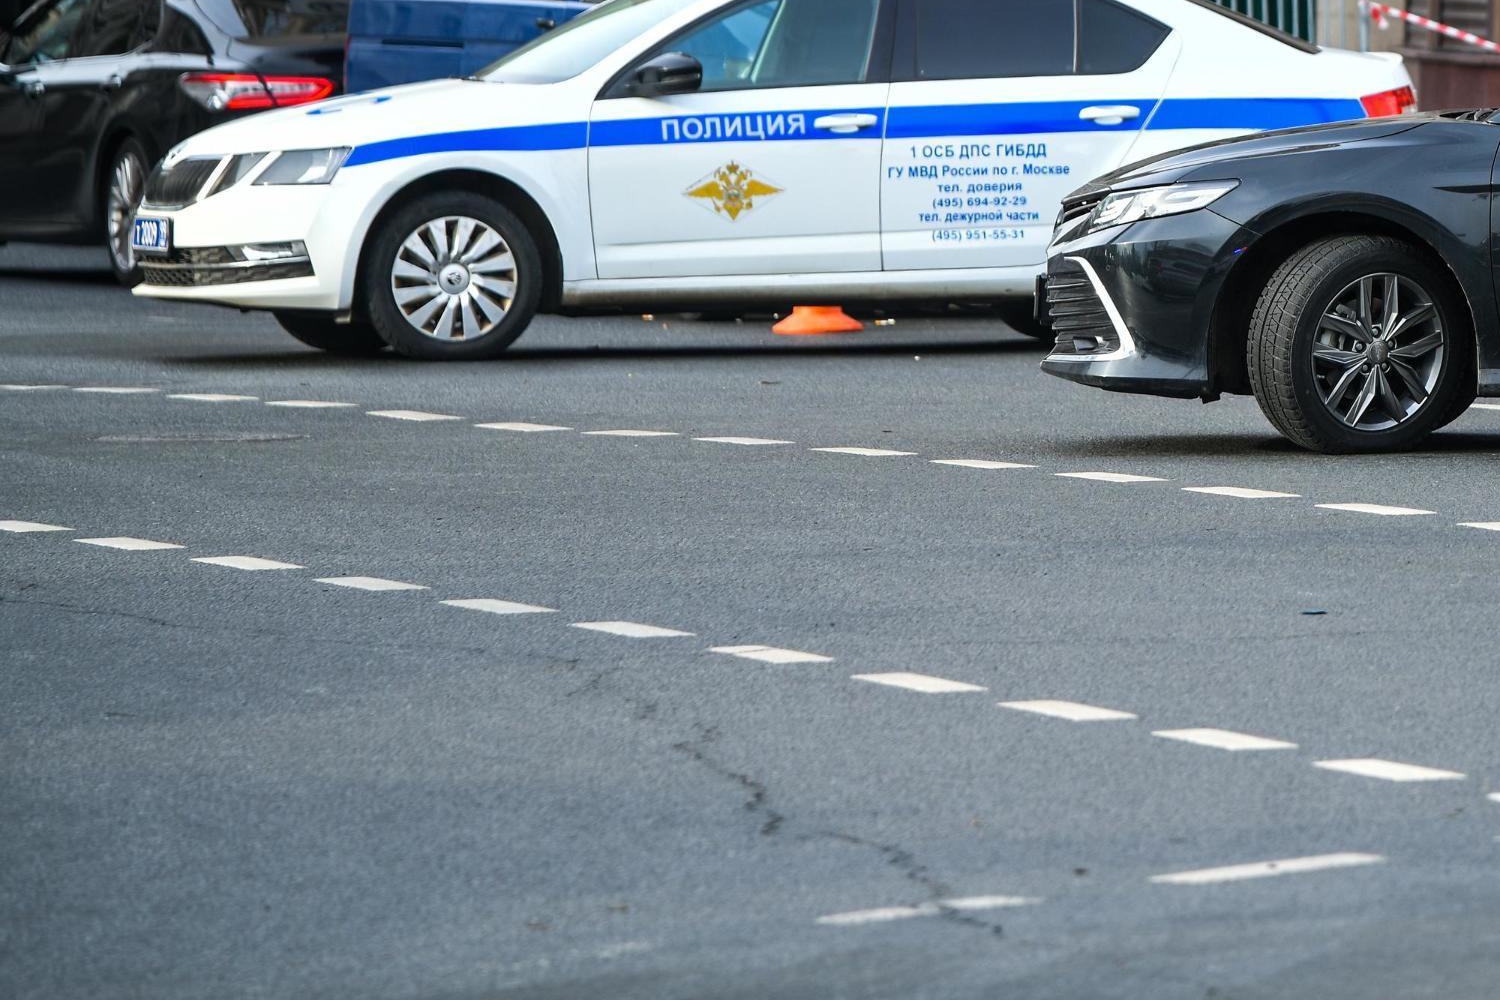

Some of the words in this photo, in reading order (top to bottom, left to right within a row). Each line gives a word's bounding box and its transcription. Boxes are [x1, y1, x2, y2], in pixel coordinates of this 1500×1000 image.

[661, 113, 806, 141] ПОЛИЦИЯ
[910, 145, 916, 158] 1
[922, 145, 955, 158] ОСБ
[959, 144, 991, 159] ДПС
[996, 143, 1047, 159] ГИБДД
[888, 166, 904, 178] ГУ
[908, 165, 938, 179] МВД
[942, 164, 988, 177] России
[992, 166, 1008, 175] по
[1023, 163, 1070, 175] Москве
[937, 183, 963, 193] тел.
[966, 182, 1022, 193] доверия
[932, 198, 963, 209] (495)
[919, 212, 942, 222] тел.
[944, 209, 1003, 223] дежурной
[1006, 210, 1039, 220] части
[932, 230, 962, 242] (495)
